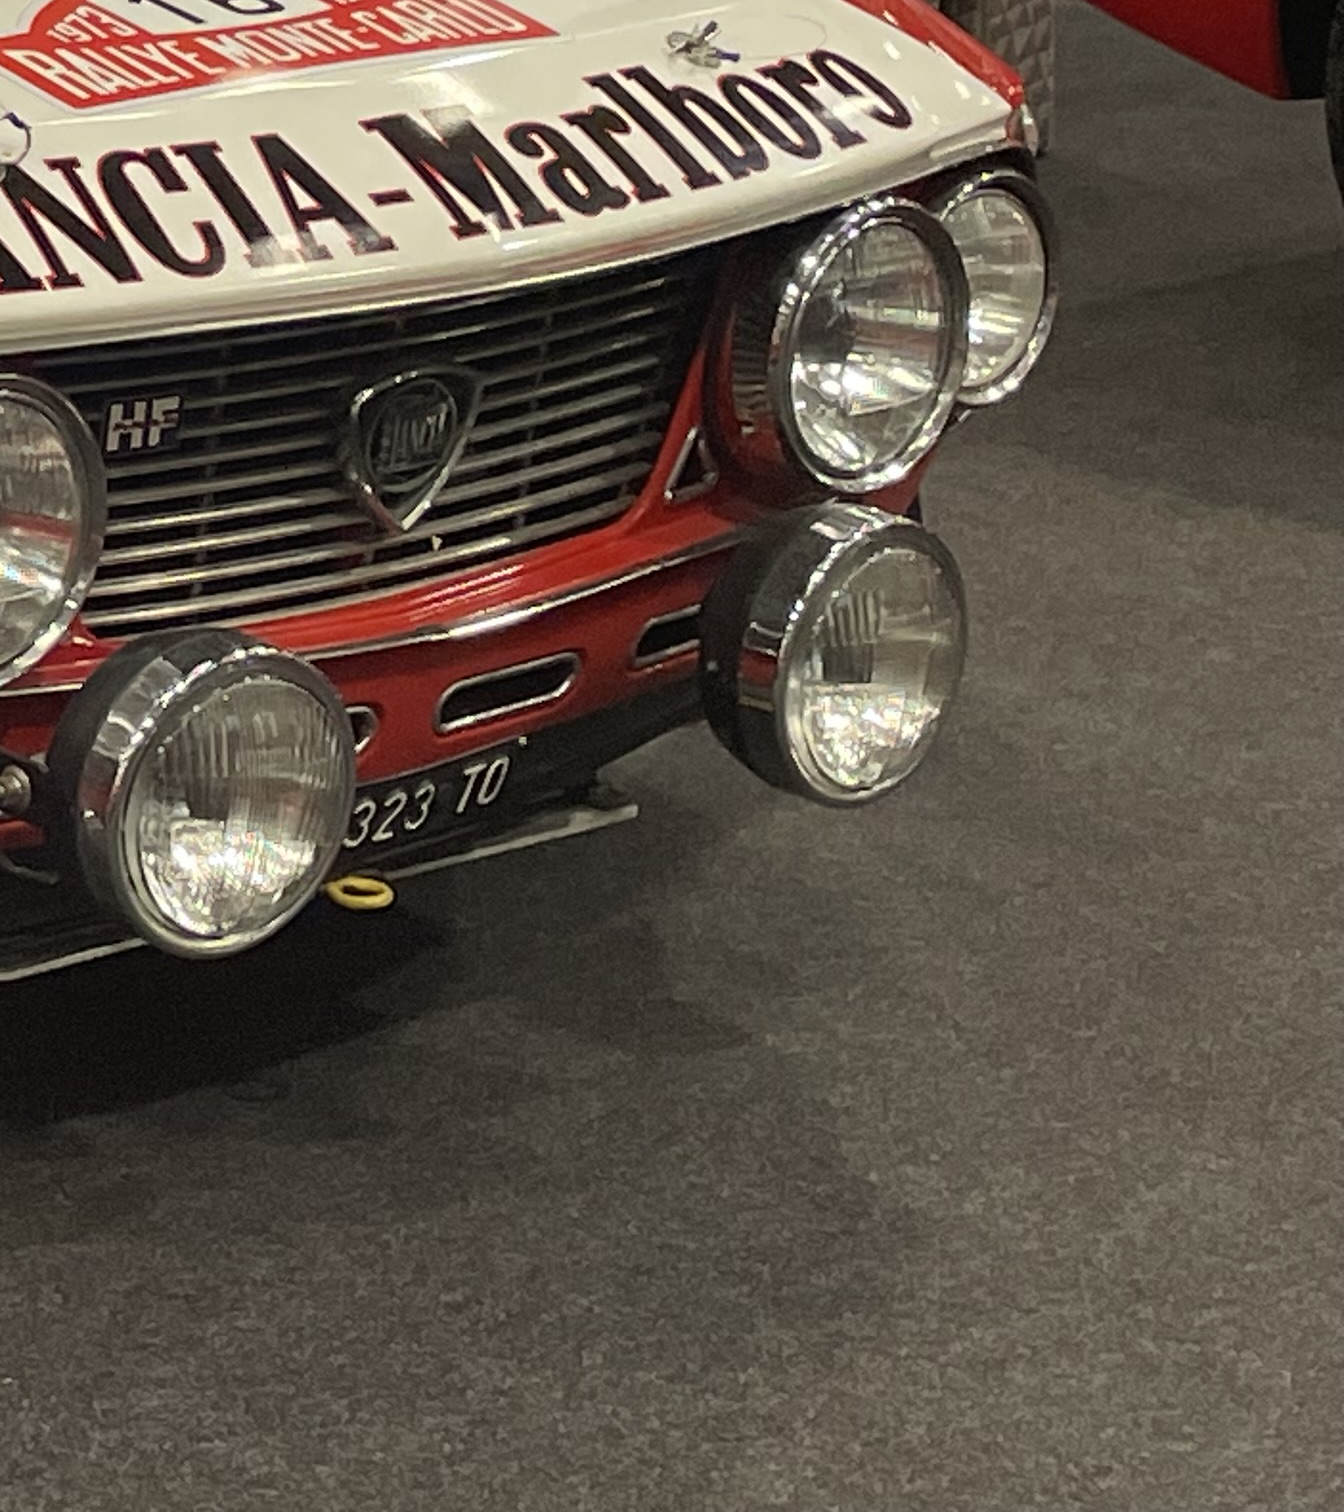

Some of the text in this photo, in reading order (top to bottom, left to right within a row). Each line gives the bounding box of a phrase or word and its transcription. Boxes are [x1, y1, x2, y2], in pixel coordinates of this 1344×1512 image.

[46, 4, 130, 43] 1973
[2, 40, 226, 100] RALLYE
[106, 395, 181, 452] HF
[456, 755, 510, 814] TO
